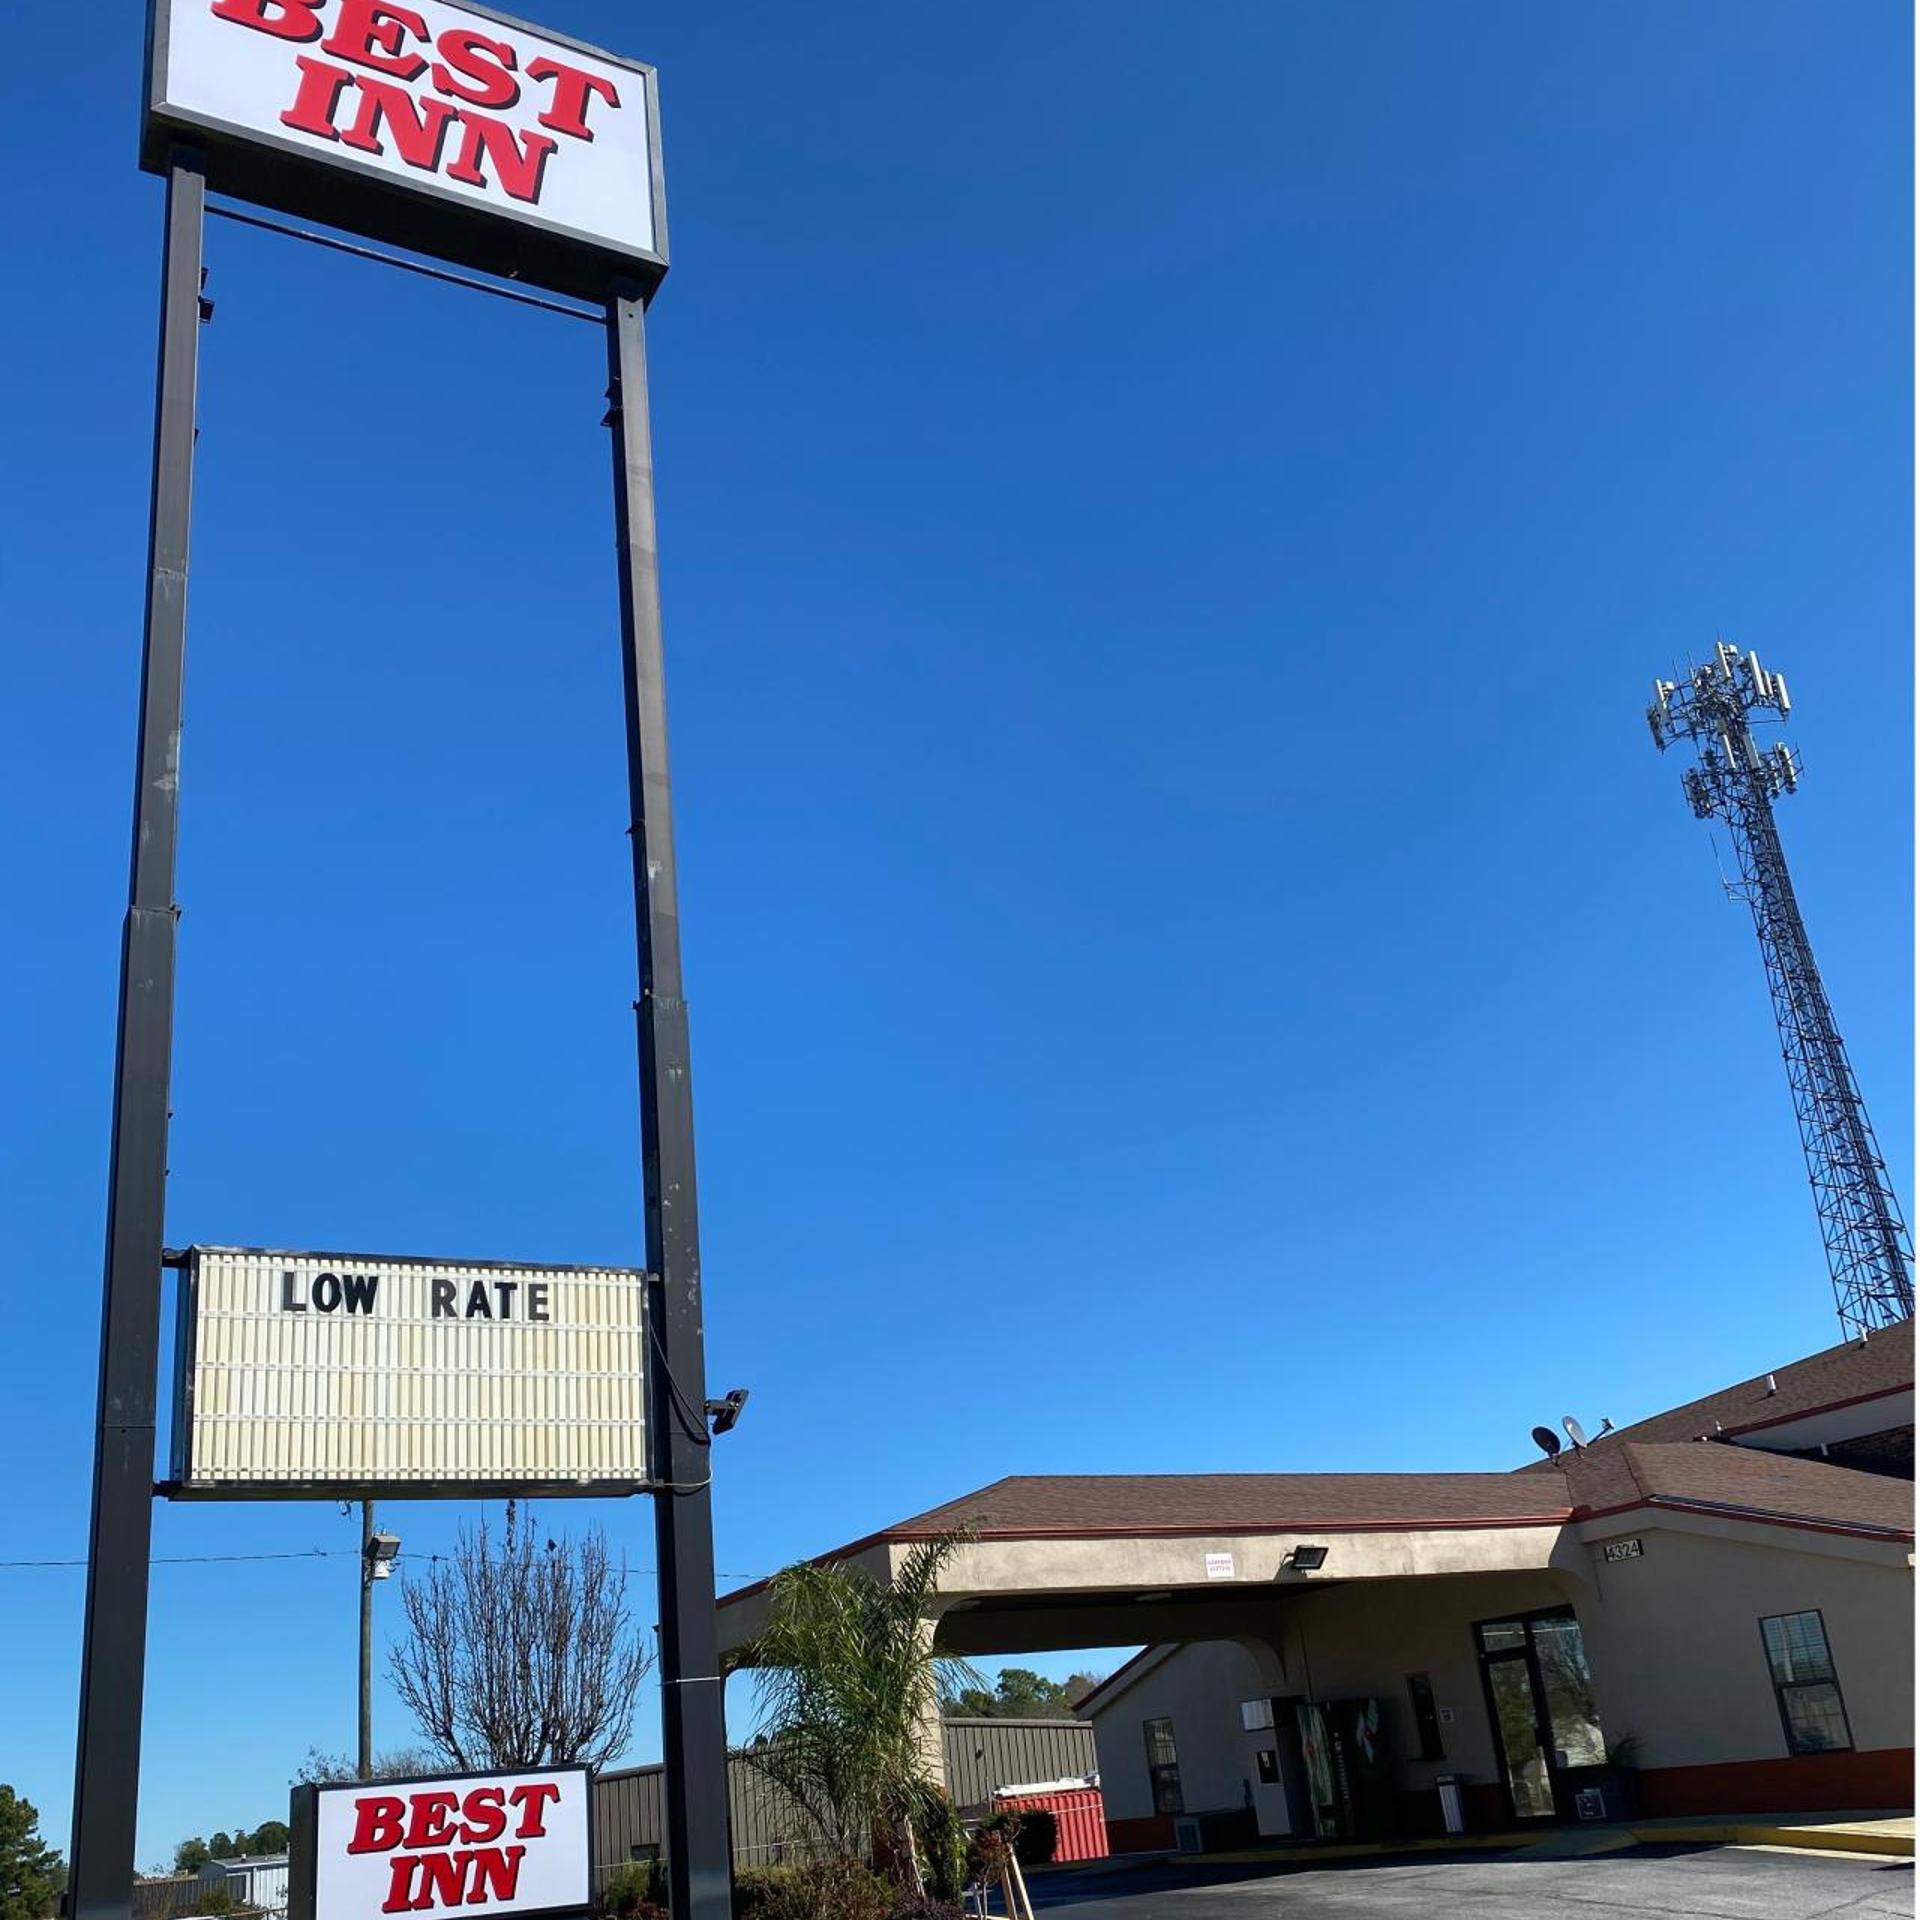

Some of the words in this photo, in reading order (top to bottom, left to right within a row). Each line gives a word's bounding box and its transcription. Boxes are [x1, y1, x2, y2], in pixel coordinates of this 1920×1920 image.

[210, 0, 621, 142] BEST
[280, 55, 558, 204] INN
[282, 1271, 379, 1315] LOW
[431, 1279, 550, 1321] RATE
[1606, 1540, 1640, 1560] 4324
[346, 1783, 561, 1855] BEST
[382, 1845, 526, 1914] INN
